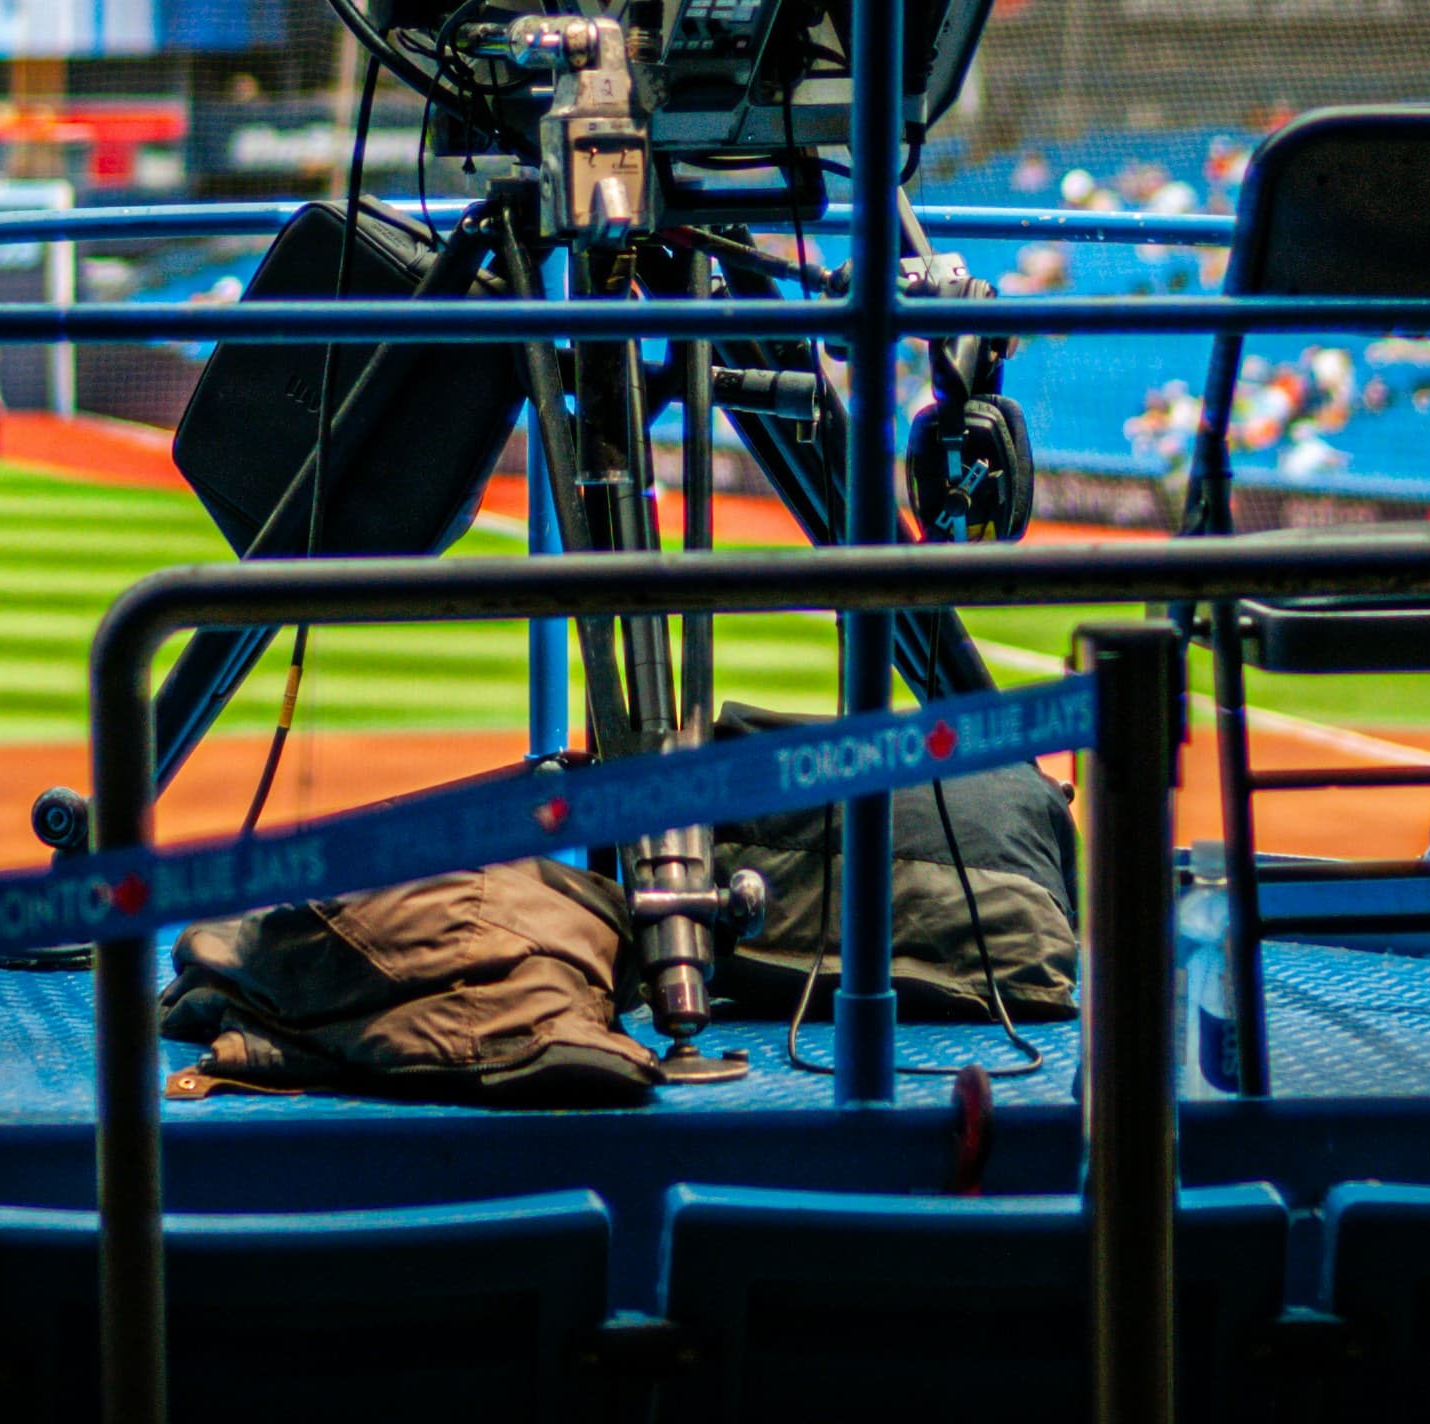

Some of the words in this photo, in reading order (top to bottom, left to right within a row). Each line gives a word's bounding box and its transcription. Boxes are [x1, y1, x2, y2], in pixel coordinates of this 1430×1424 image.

[774, 727, 918, 792] TORONTO
[958, 704, 1024, 760] BLUE
[1029, 690, 1093, 743] JAYS
[152, 857, 234, 911] BLUE
[244, 838, 327, 893] JAYS
